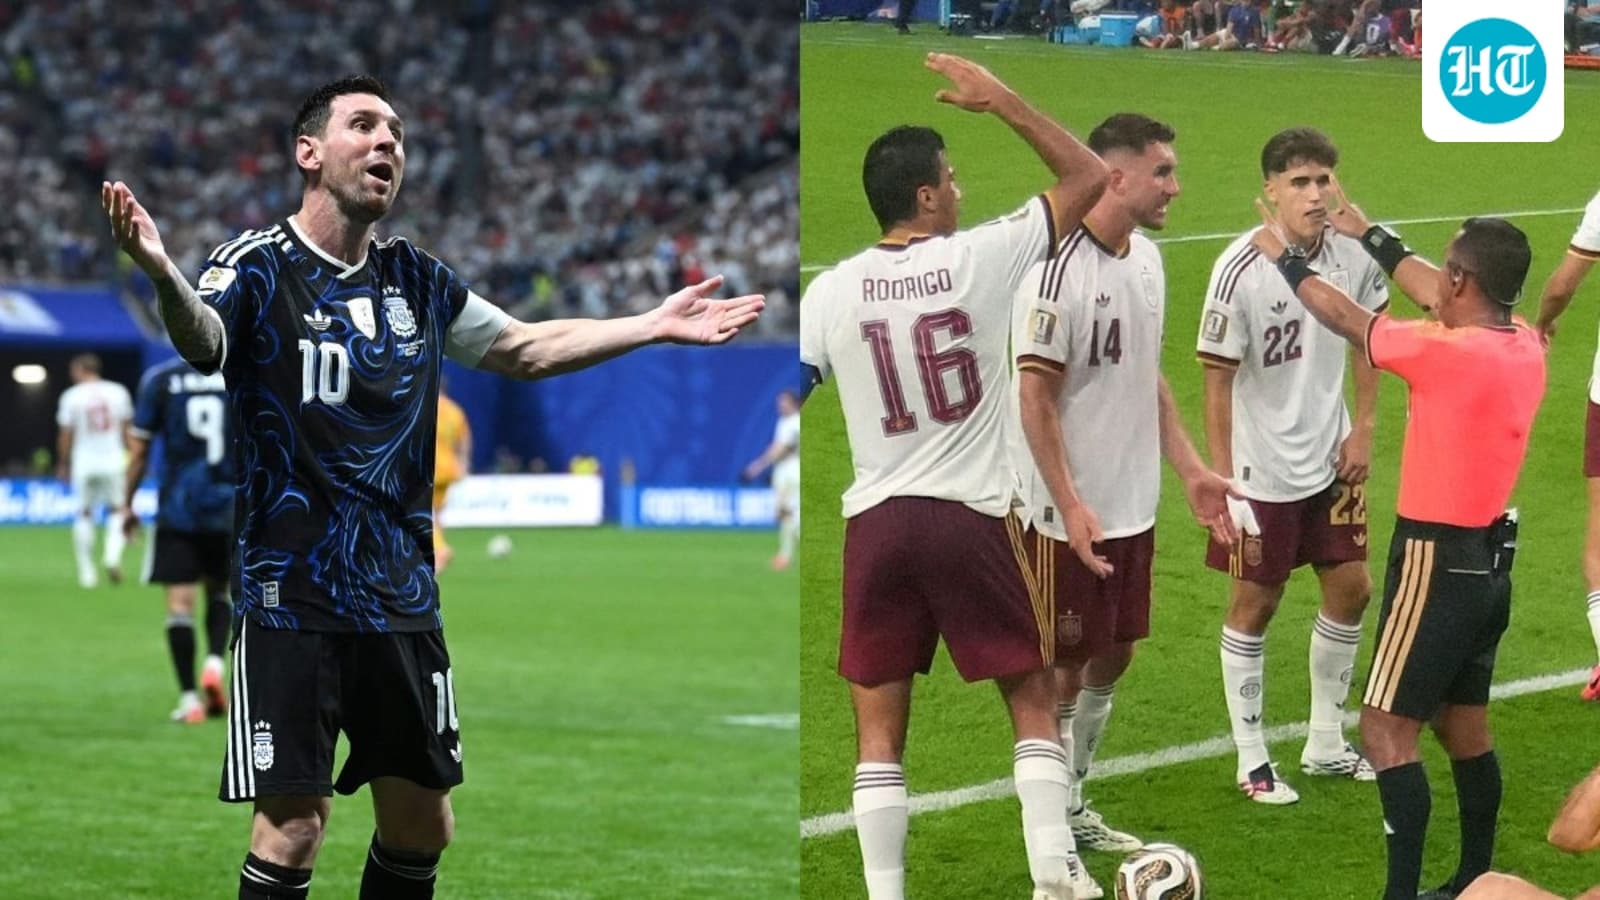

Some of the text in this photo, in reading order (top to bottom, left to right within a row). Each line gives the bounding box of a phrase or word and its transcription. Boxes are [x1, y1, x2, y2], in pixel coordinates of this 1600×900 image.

[862, 268, 952, 302] RODRIGO
[1087, 318, 1122, 367] 14
[1263, 319, 1303, 368] 22
[298, 338, 351, 406] 10
[859, 307, 984, 438] 16
[186, 394, 225, 466] 9
